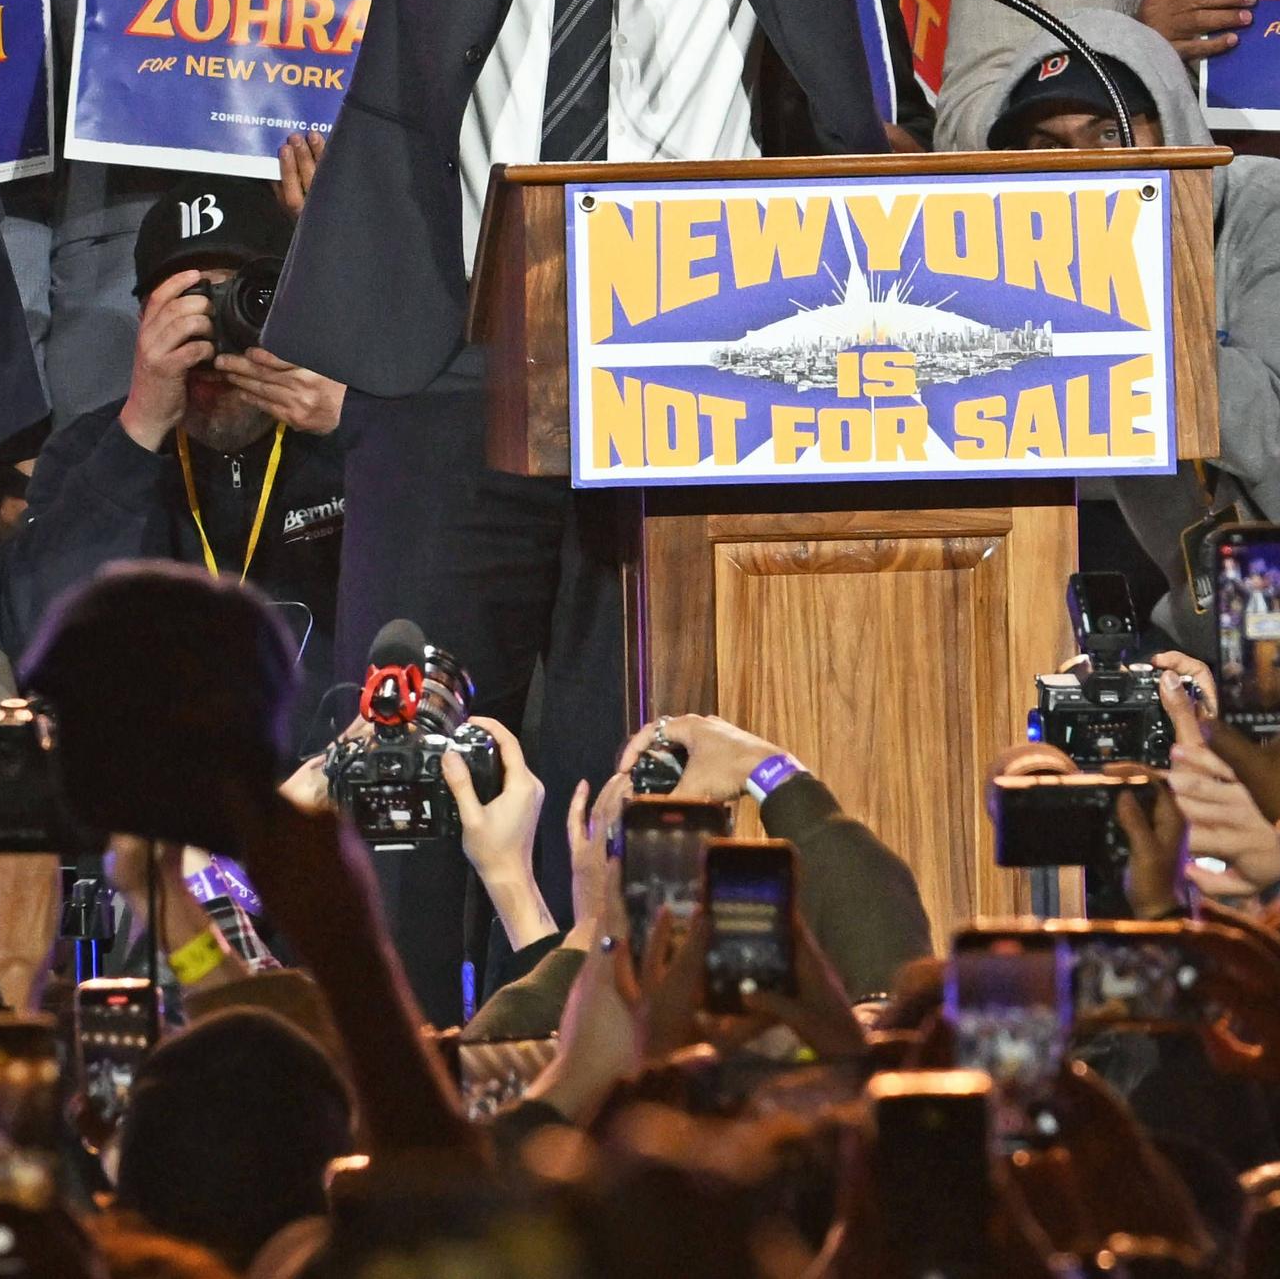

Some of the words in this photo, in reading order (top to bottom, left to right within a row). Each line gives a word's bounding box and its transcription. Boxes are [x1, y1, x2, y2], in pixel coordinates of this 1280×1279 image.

[137, 56, 178, 74] FOR
[185, 55, 256, 81] NEW
[263, 62, 345, 90] YORK
[588, 196, 830, 345] NEW
[843, 190, 1152, 331] YORK
[837, 350, 917, 398] IS
[590, 368, 746, 469] NOT
[771, 402, 928, 464] FOR
[953, 353, 1156, 460] SALE
[283, 497, 345, 532] Bernie
